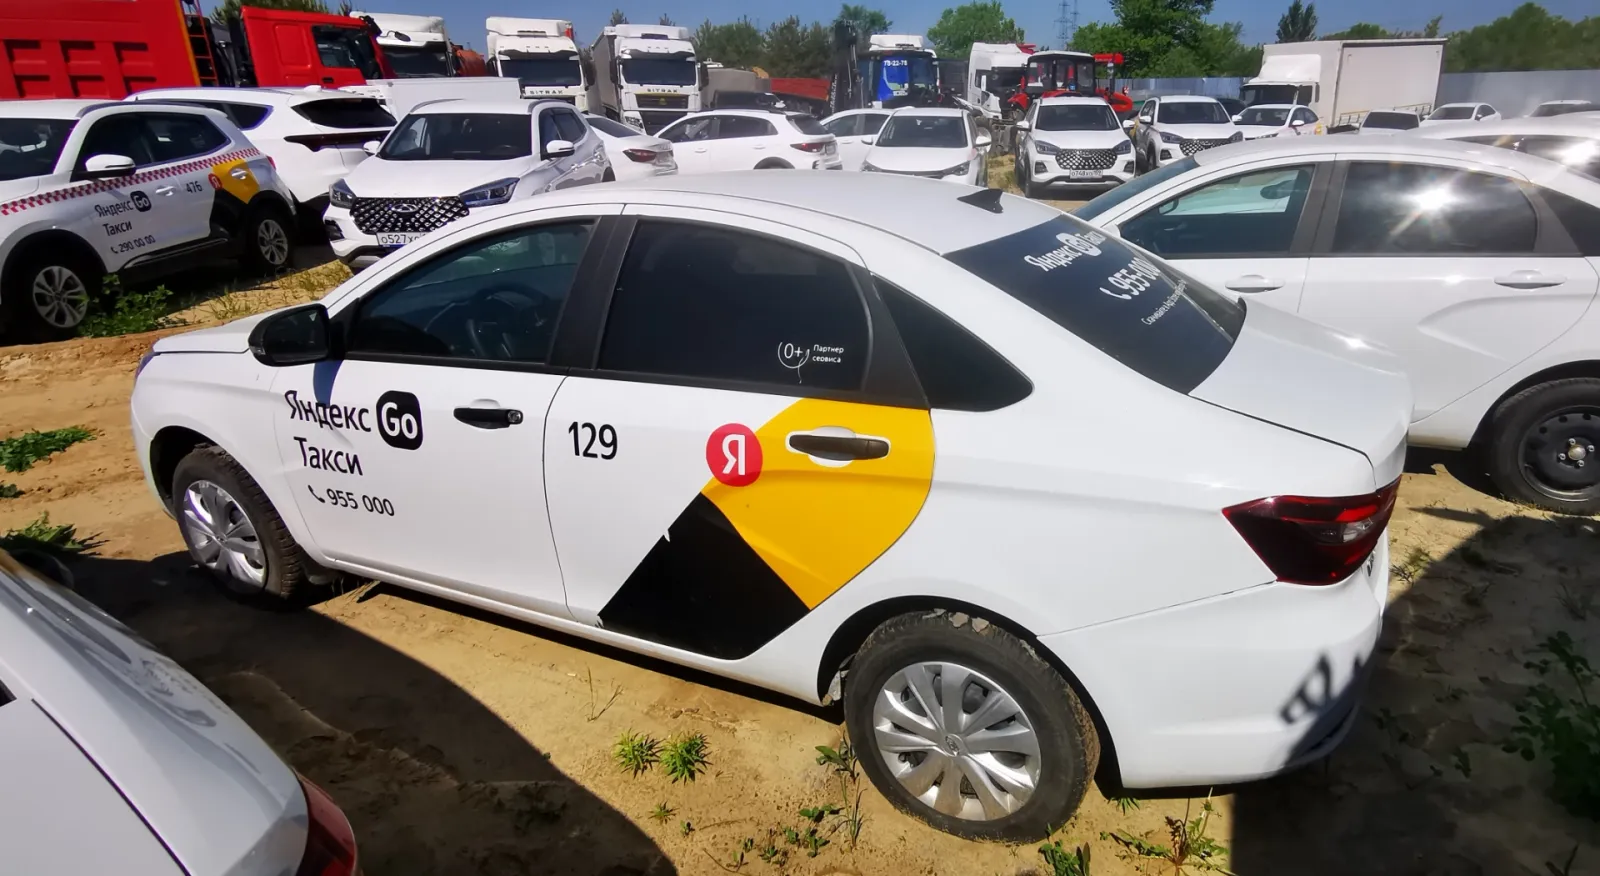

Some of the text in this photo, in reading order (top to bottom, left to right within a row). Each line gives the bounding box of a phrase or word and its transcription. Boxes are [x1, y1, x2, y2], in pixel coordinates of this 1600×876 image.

[185, 180, 203, 194] 476
[94, 201, 133, 217] Яндекс
[102, 220, 133, 237] Такси
[117, 234, 156, 253] 290 00 00
[1024, 245, 1083, 272] Яндекс
[783, 343, 804, 359] 0+
[813, 344, 844, 354] Партнер
[812, 355, 842, 363] сервиса
[284, 389, 418, 440] Яндекс Go
[568, 421, 618, 460] 129
[293, 436, 363, 476] Такси
[721, 433, 746, 476] Я
[326, 488, 395, 517] 955 000
